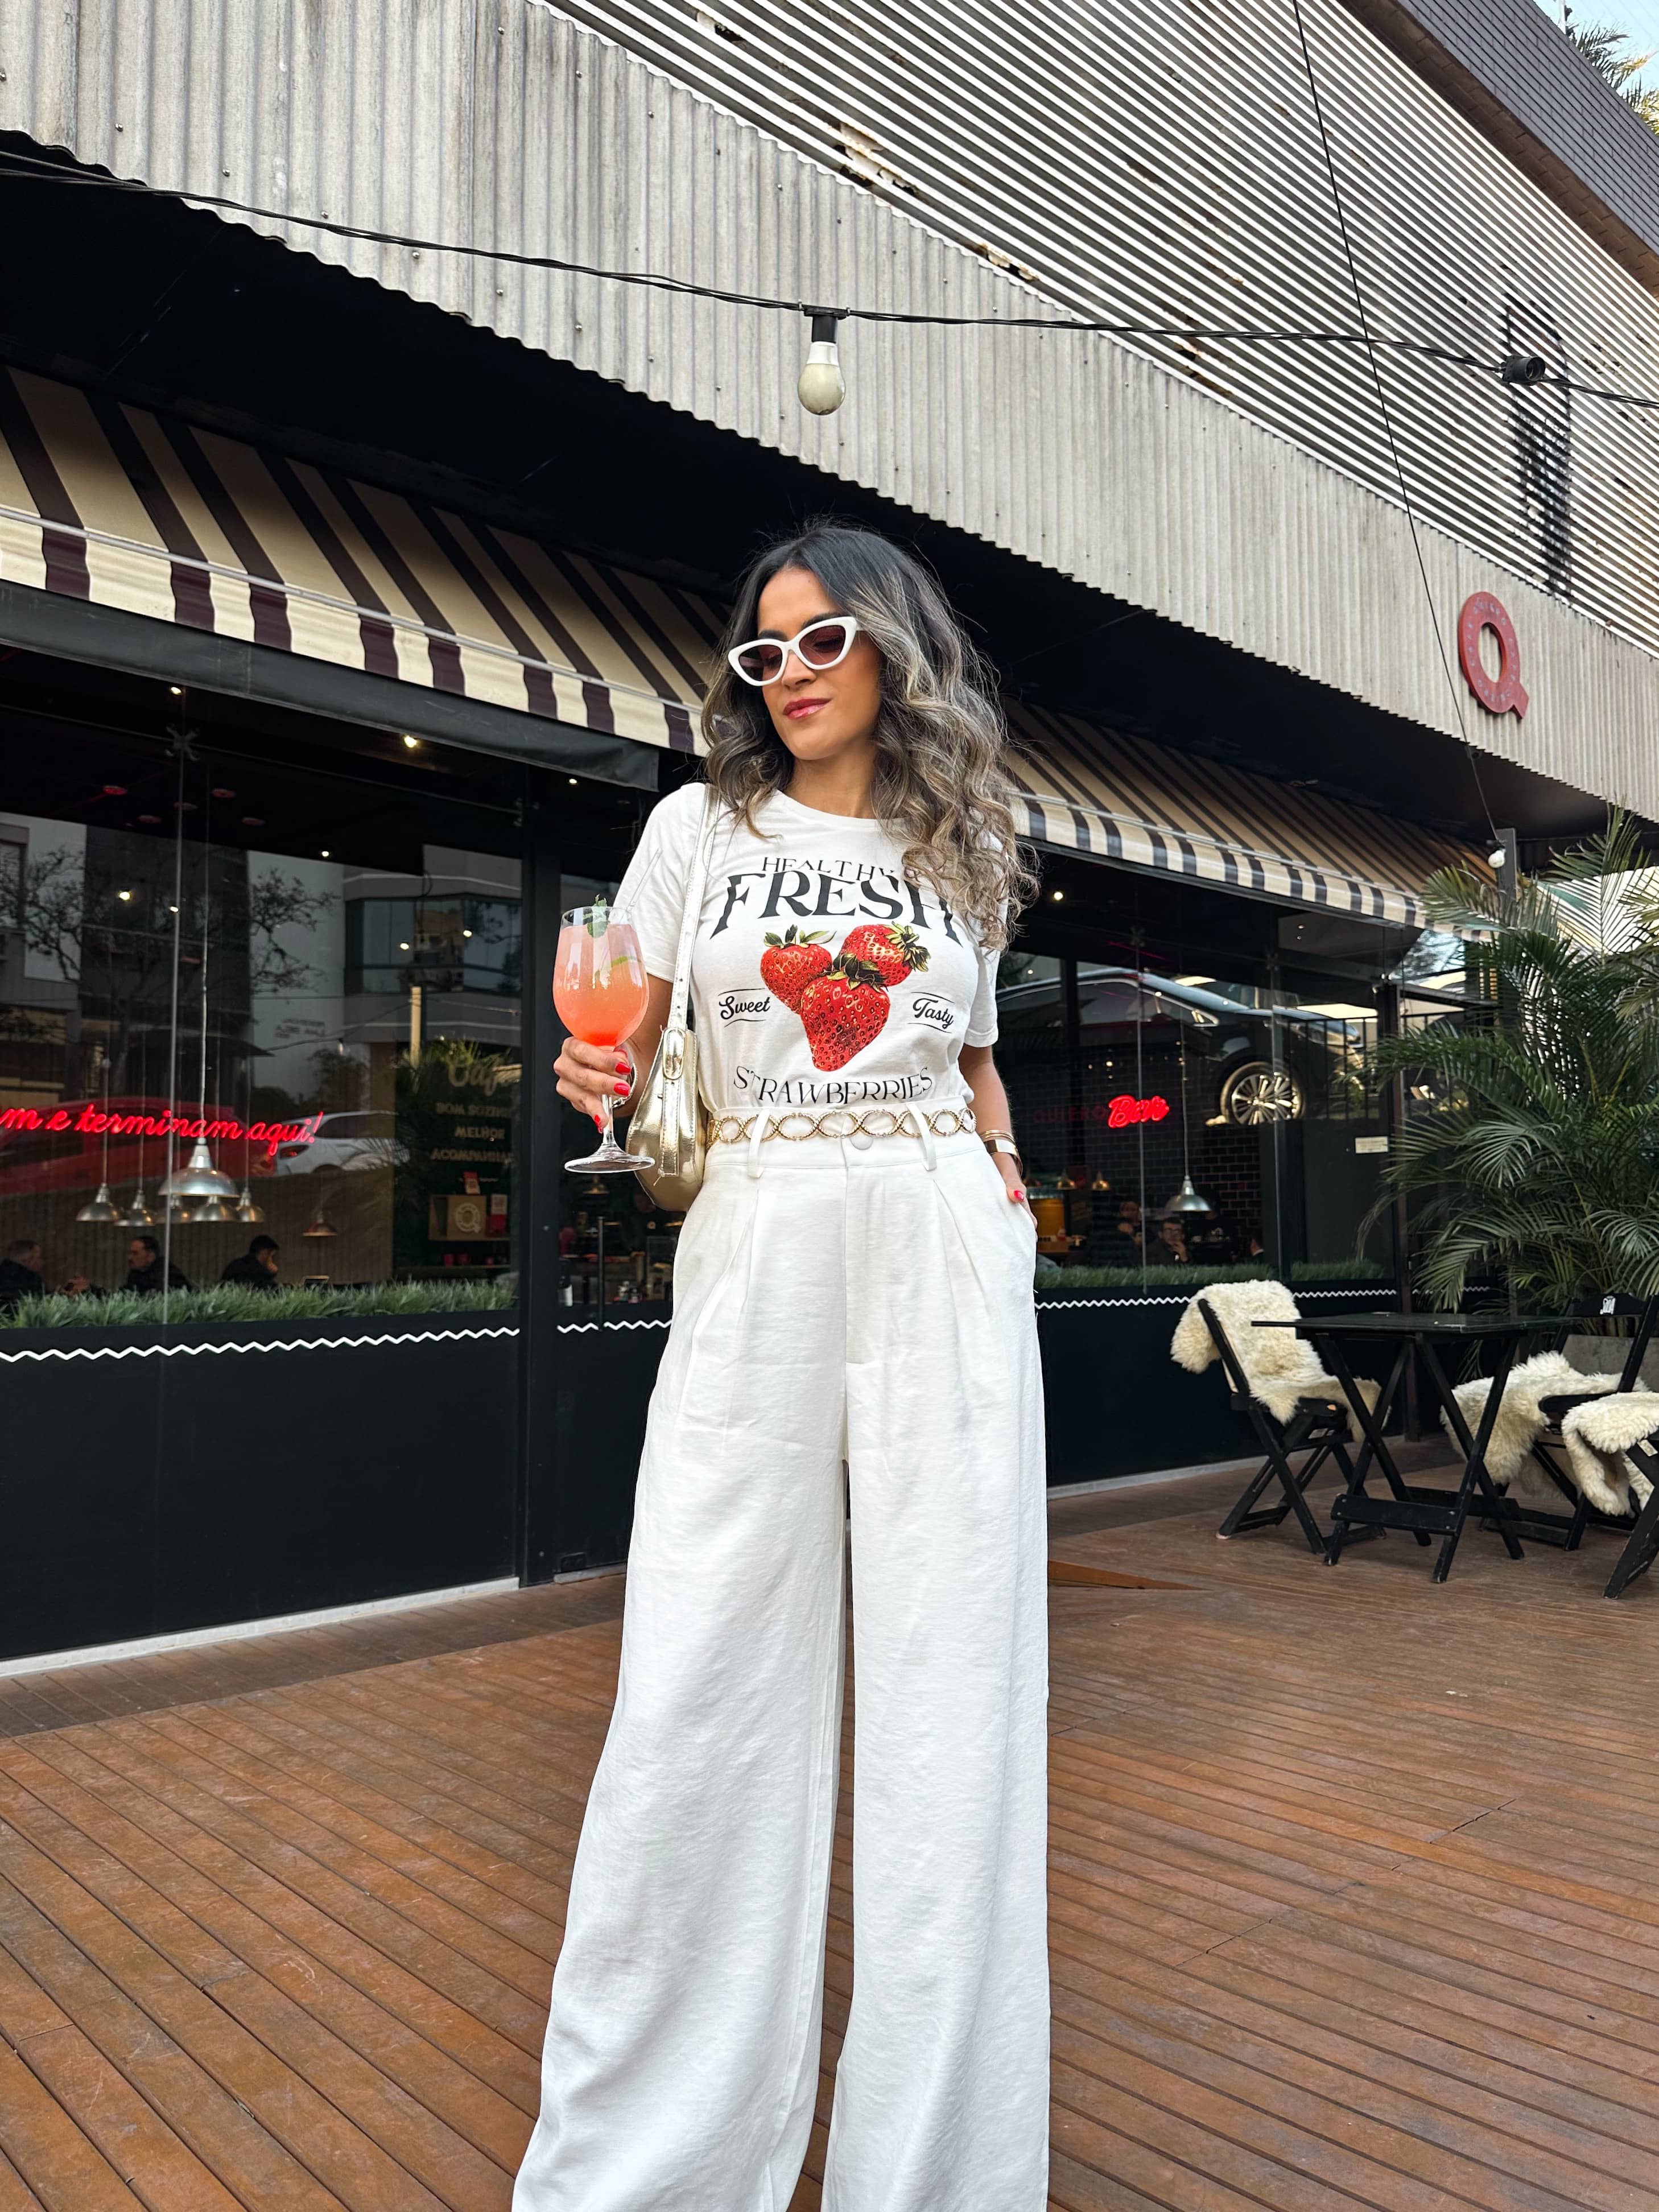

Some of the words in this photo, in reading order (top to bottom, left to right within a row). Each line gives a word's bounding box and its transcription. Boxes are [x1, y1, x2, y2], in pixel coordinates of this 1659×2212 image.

[1458, 591, 1529, 719] Q
[710, 870, 964, 948] FRESH
[719, 996, 770, 1021] Sweet
[913, 998, 954, 1029] Tasty
[733, 1066, 933, 1105] STRAWBERRIES
[45, 1110, 72, 1131] e
[74, 1103, 244, 1140] terminam
[246, 1111, 324, 1156] aqui!
[1108, 1095, 1170, 1129] Bar
